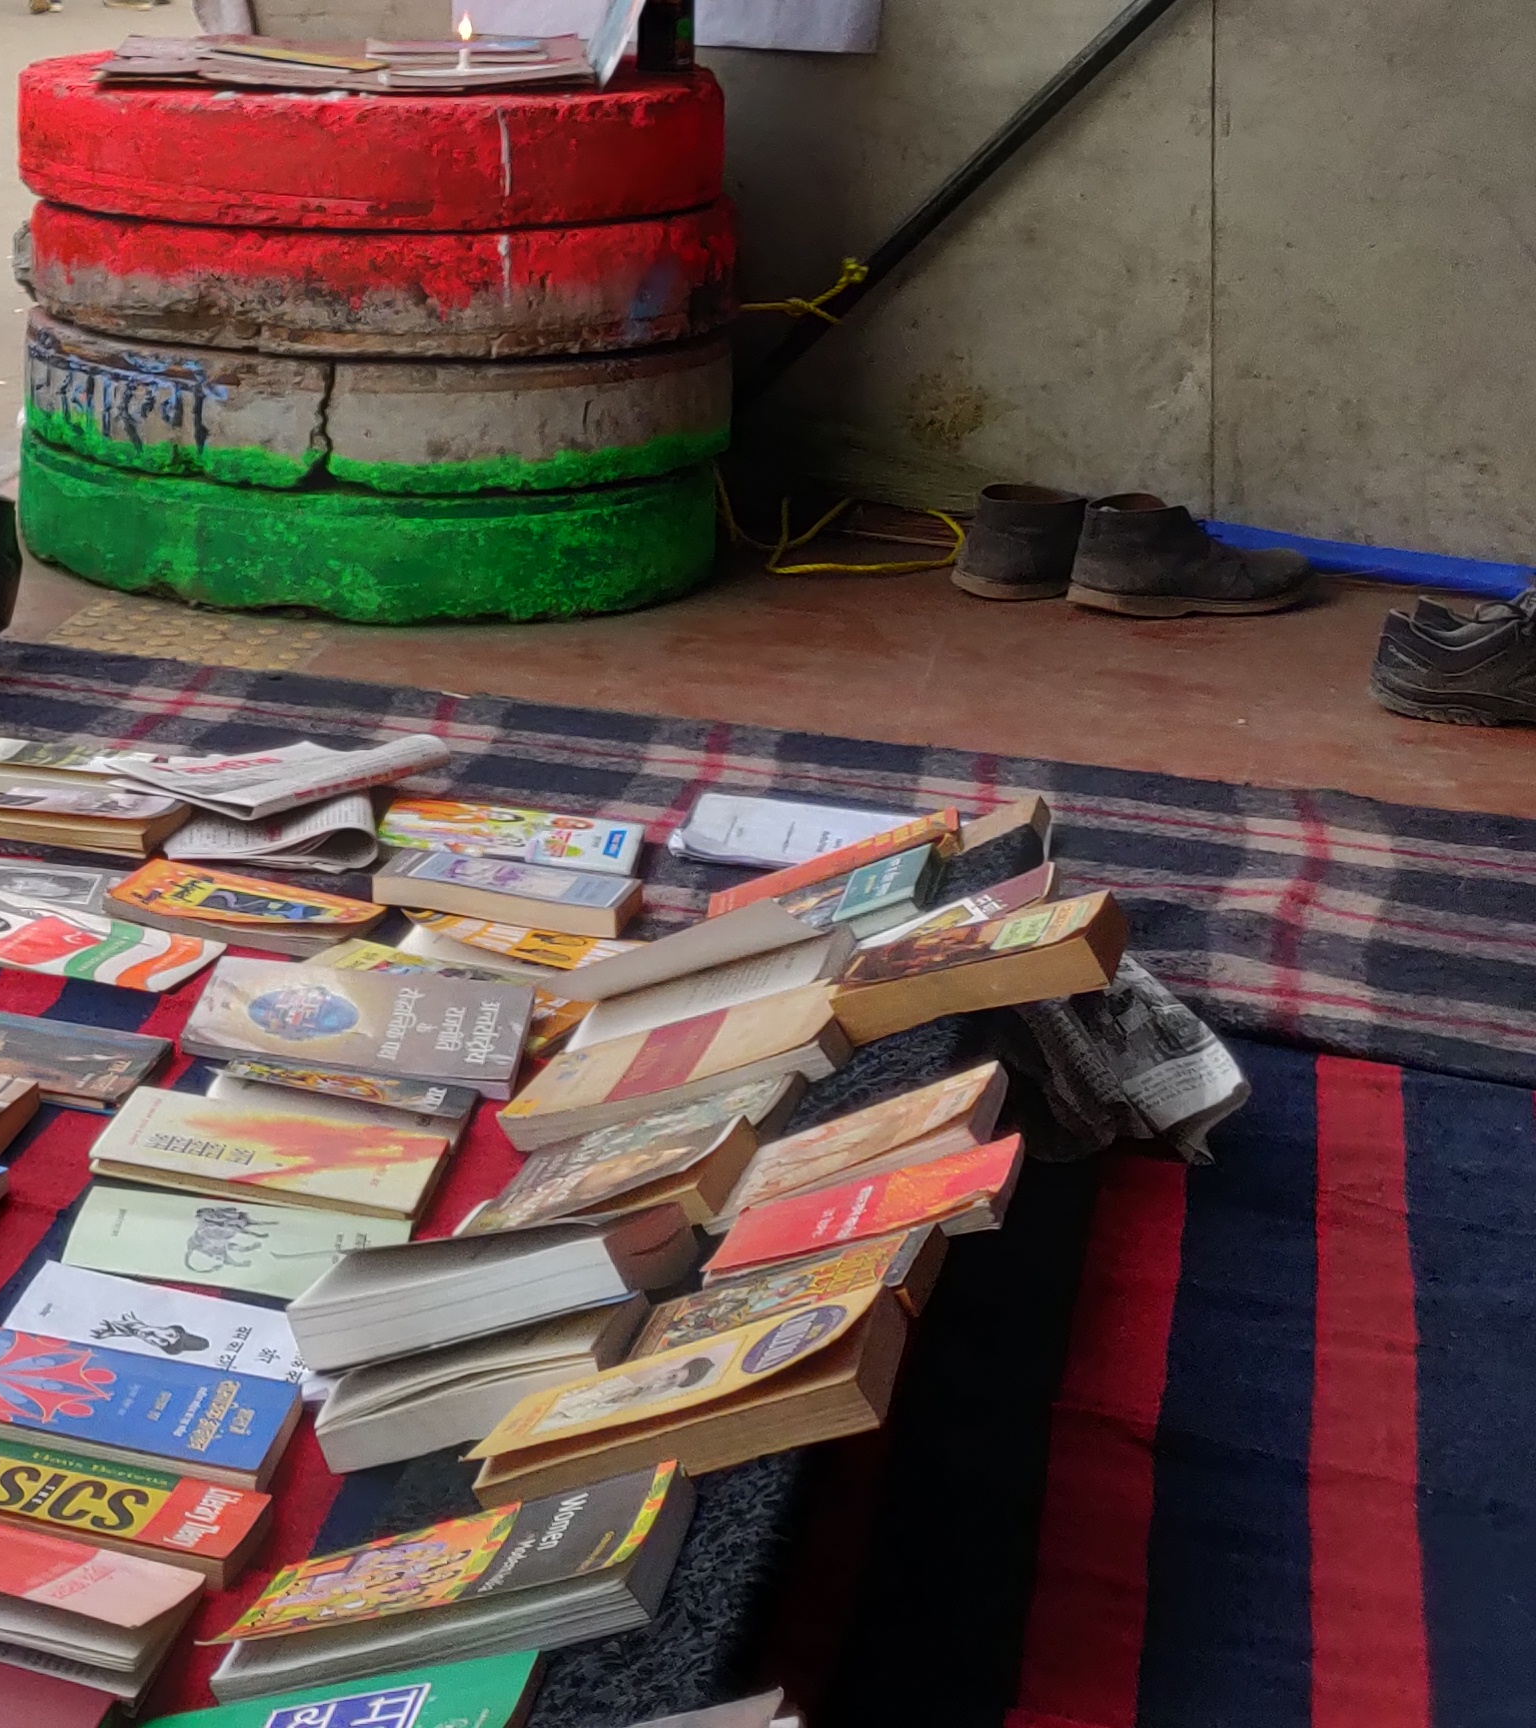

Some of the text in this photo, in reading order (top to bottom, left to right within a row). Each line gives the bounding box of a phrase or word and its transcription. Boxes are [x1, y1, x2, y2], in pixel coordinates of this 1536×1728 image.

[413, 1021, 436, 1033] के
[431, 1005, 468, 1051] राजनीति
[160, 1486, 247, 1551] Literary Theory
[511, 1486, 608, 1557] Women
